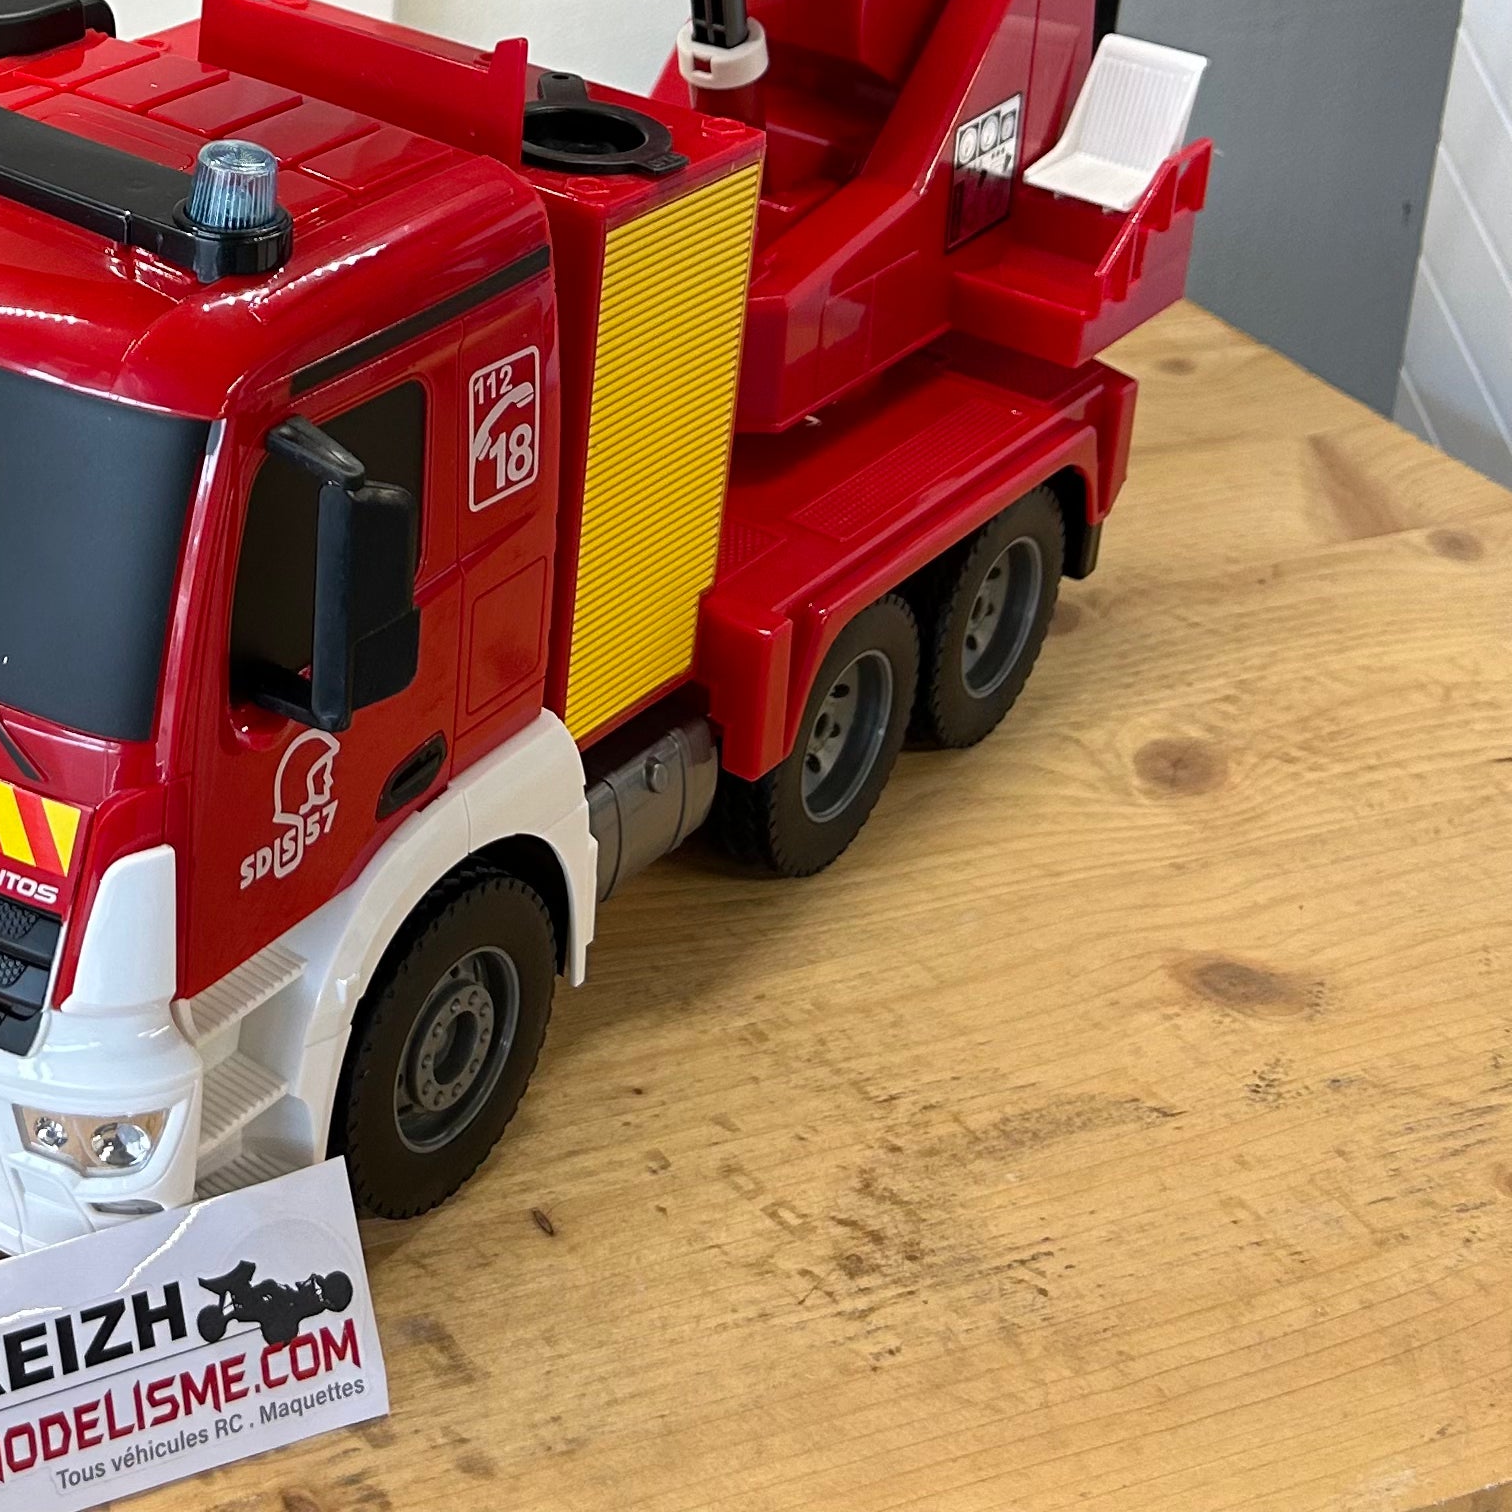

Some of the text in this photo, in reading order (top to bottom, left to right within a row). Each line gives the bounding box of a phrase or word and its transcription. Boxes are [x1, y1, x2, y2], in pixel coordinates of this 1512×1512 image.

[474, 364, 513, 405] 112
[489, 423, 533, 489] 18
[56, 1460, 107, 1489] Tous
[112, 1426, 210, 1472] véhicules
[214, 1413, 245, 1440] RC
[259, 1377, 365, 1425] Maquettes
